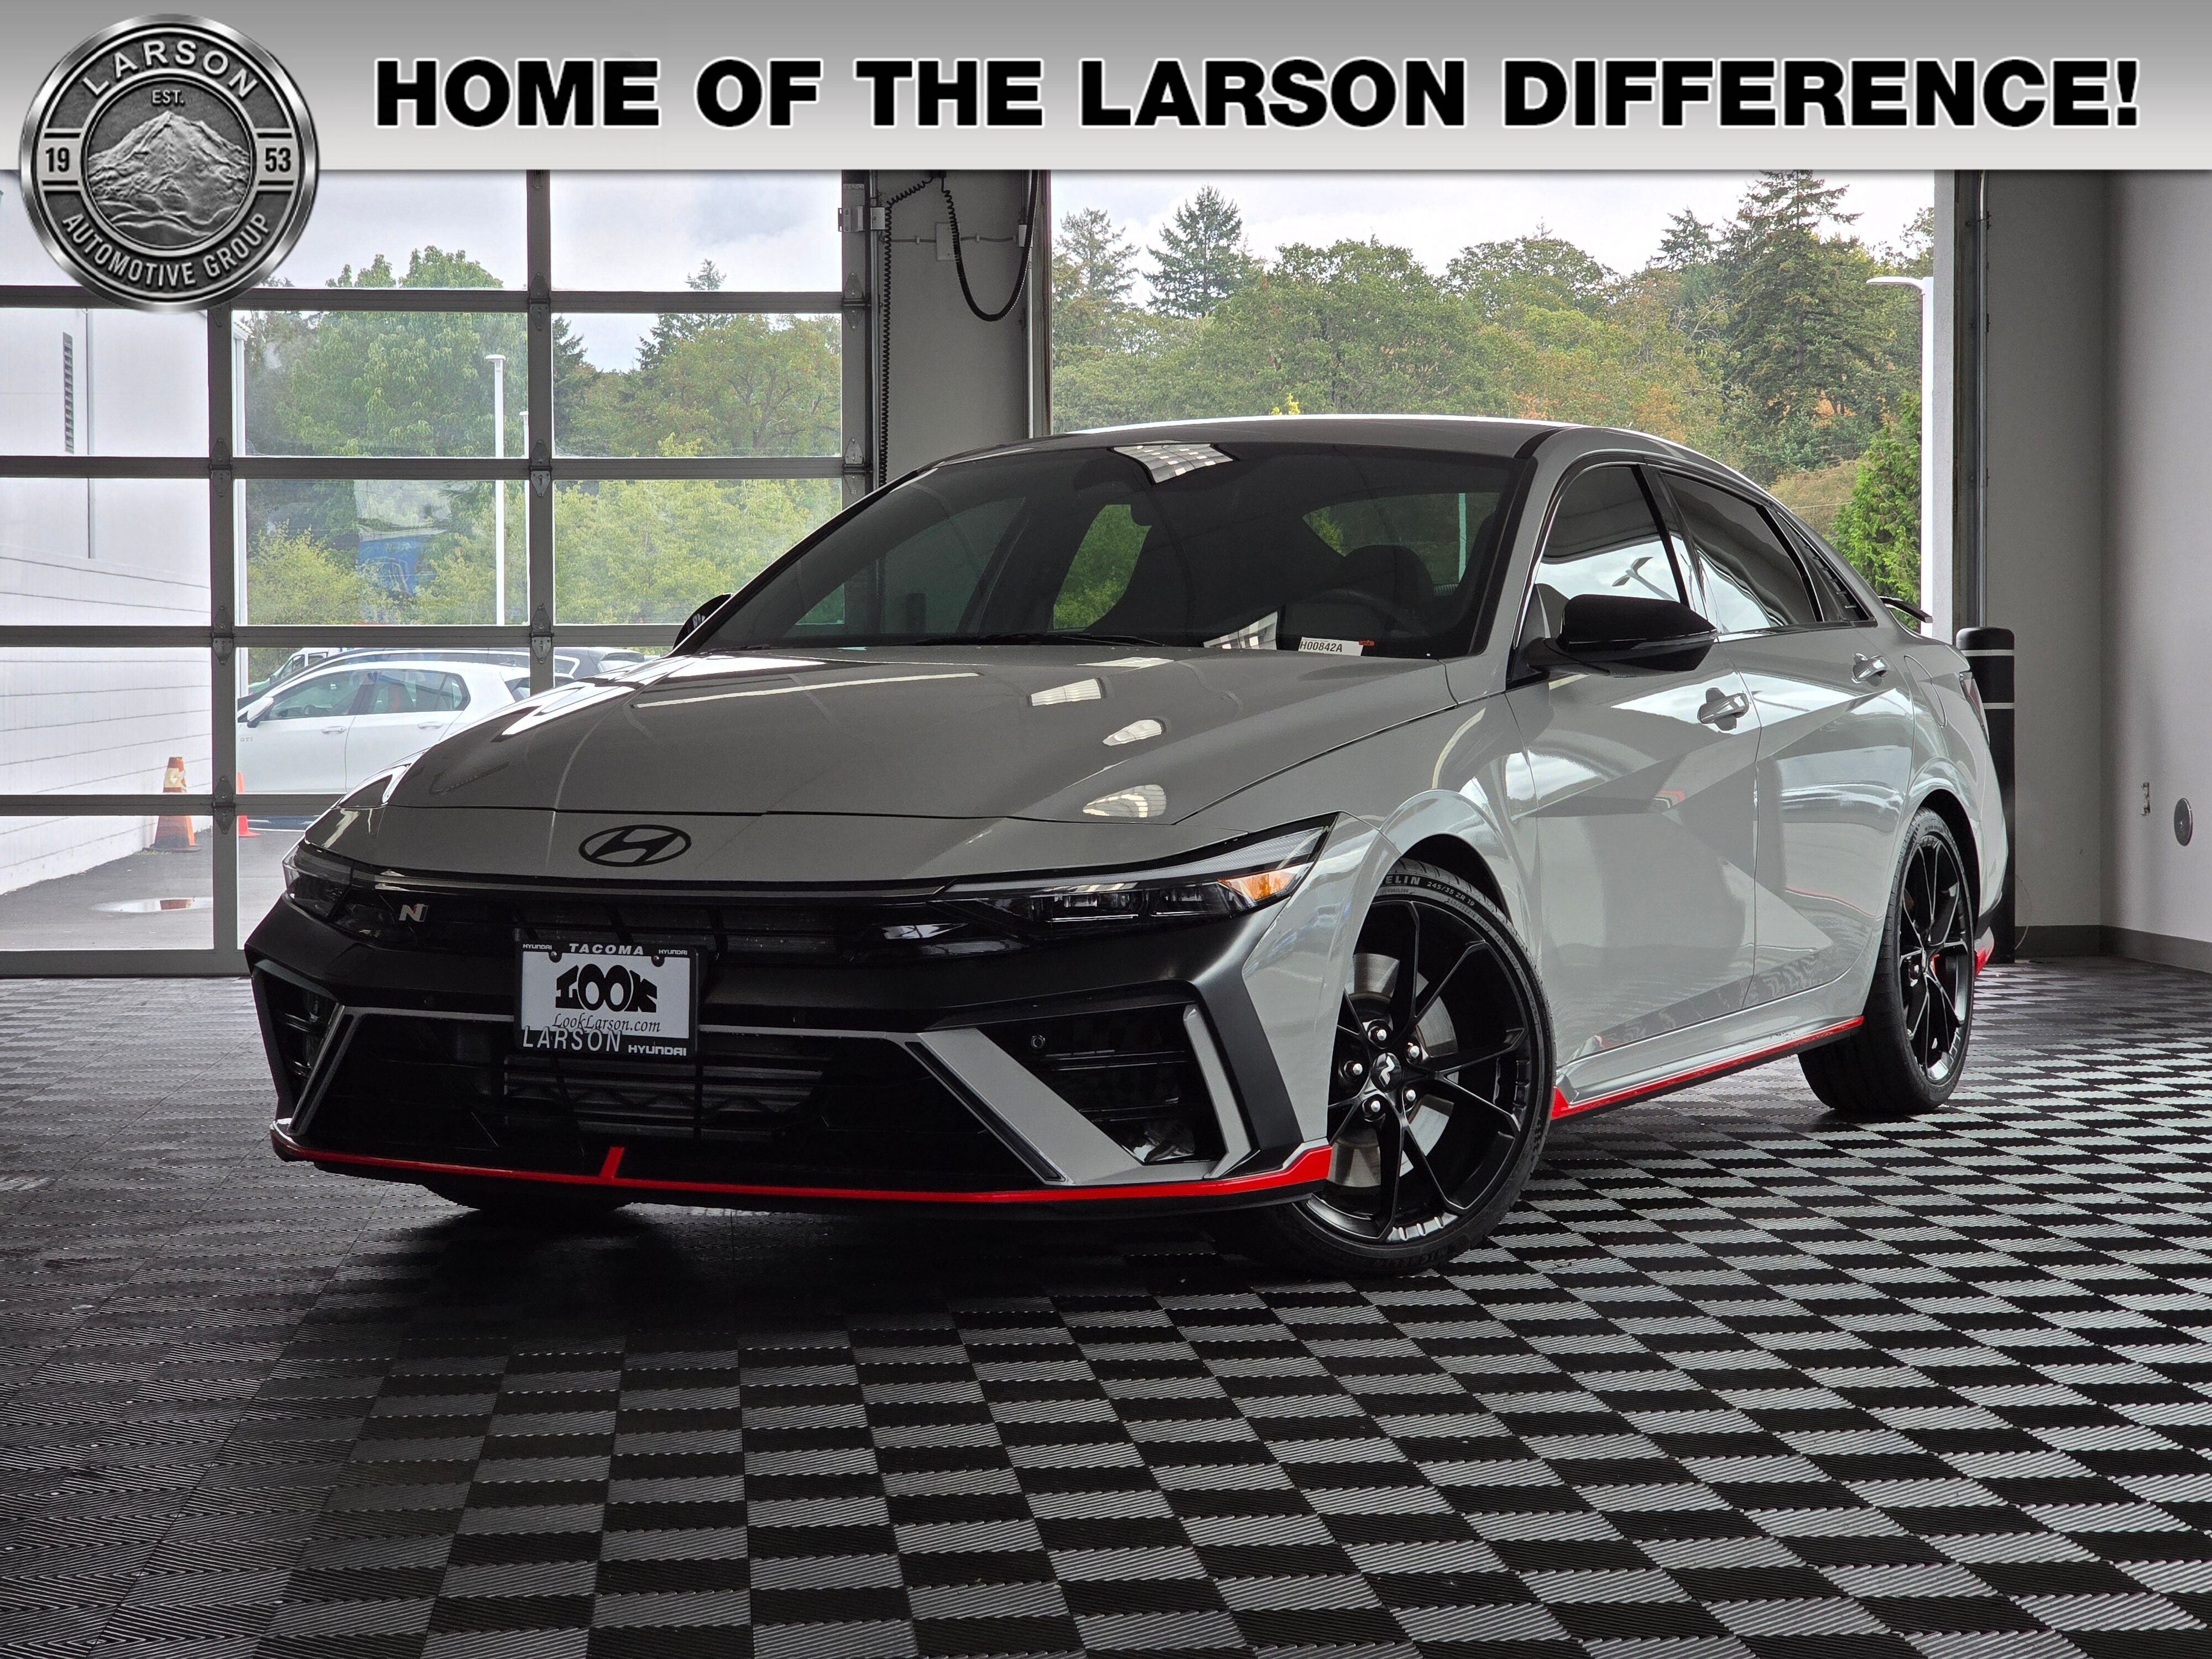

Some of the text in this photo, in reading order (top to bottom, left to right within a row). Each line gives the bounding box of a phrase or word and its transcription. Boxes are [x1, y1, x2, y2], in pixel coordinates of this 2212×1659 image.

[1300, 641, 1342, 652] H00842A
[1385, 875, 1475, 907] ELIN 245/35 ZR 19
[569, 943, 644, 956] TACOMA
[555, 963, 658, 1013] LOOK
[552, 1012, 661, 1033] LookLarson.com
[523, 1025, 623, 1052] LARSON
[628, 1044, 687, 1057] HYUNDAI
